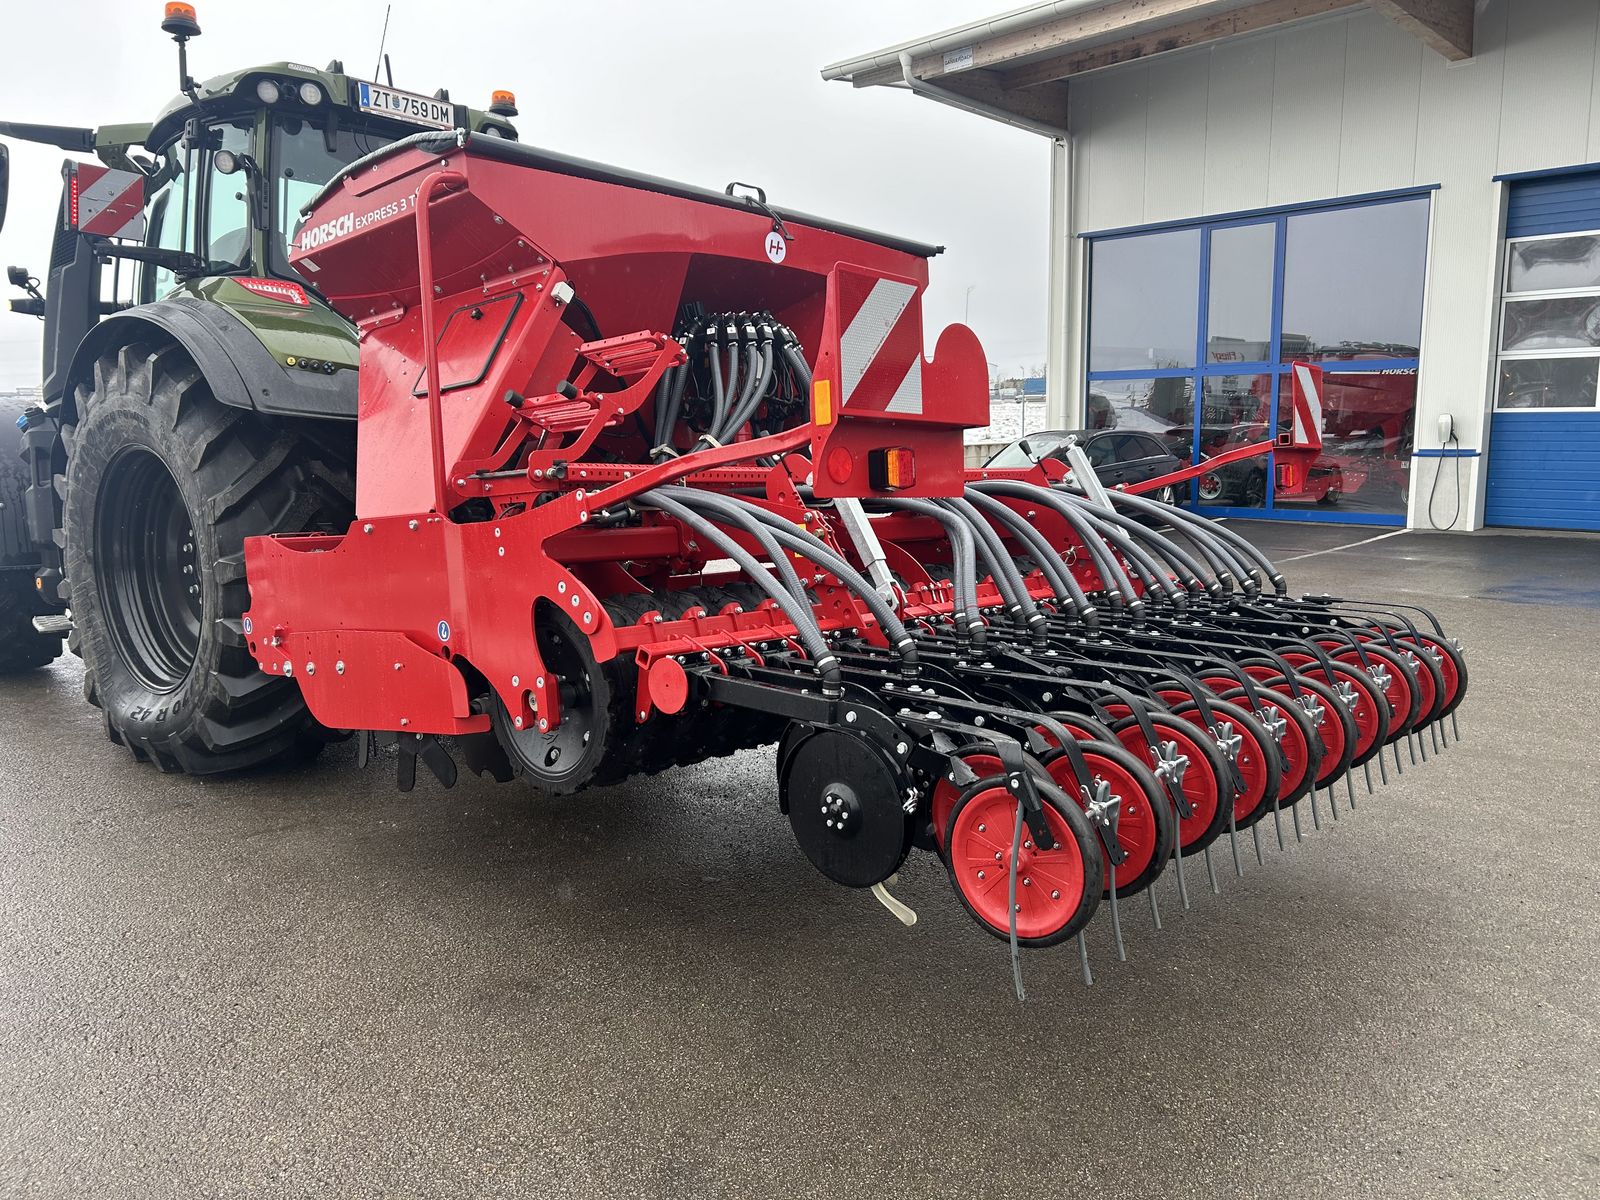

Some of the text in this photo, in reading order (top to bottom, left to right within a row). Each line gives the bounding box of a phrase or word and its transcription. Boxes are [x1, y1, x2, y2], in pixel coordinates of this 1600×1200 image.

[372, 89, 391, 109] ZT
[402, 97, 428, 118] 759
[431, 104, 449, 123] DM
[301, 194, 417, 251] HORSCH EXPRESS 3 T
[1381, 367, 1417, 375] HORSC
[130, 706, 153, 722] 42
